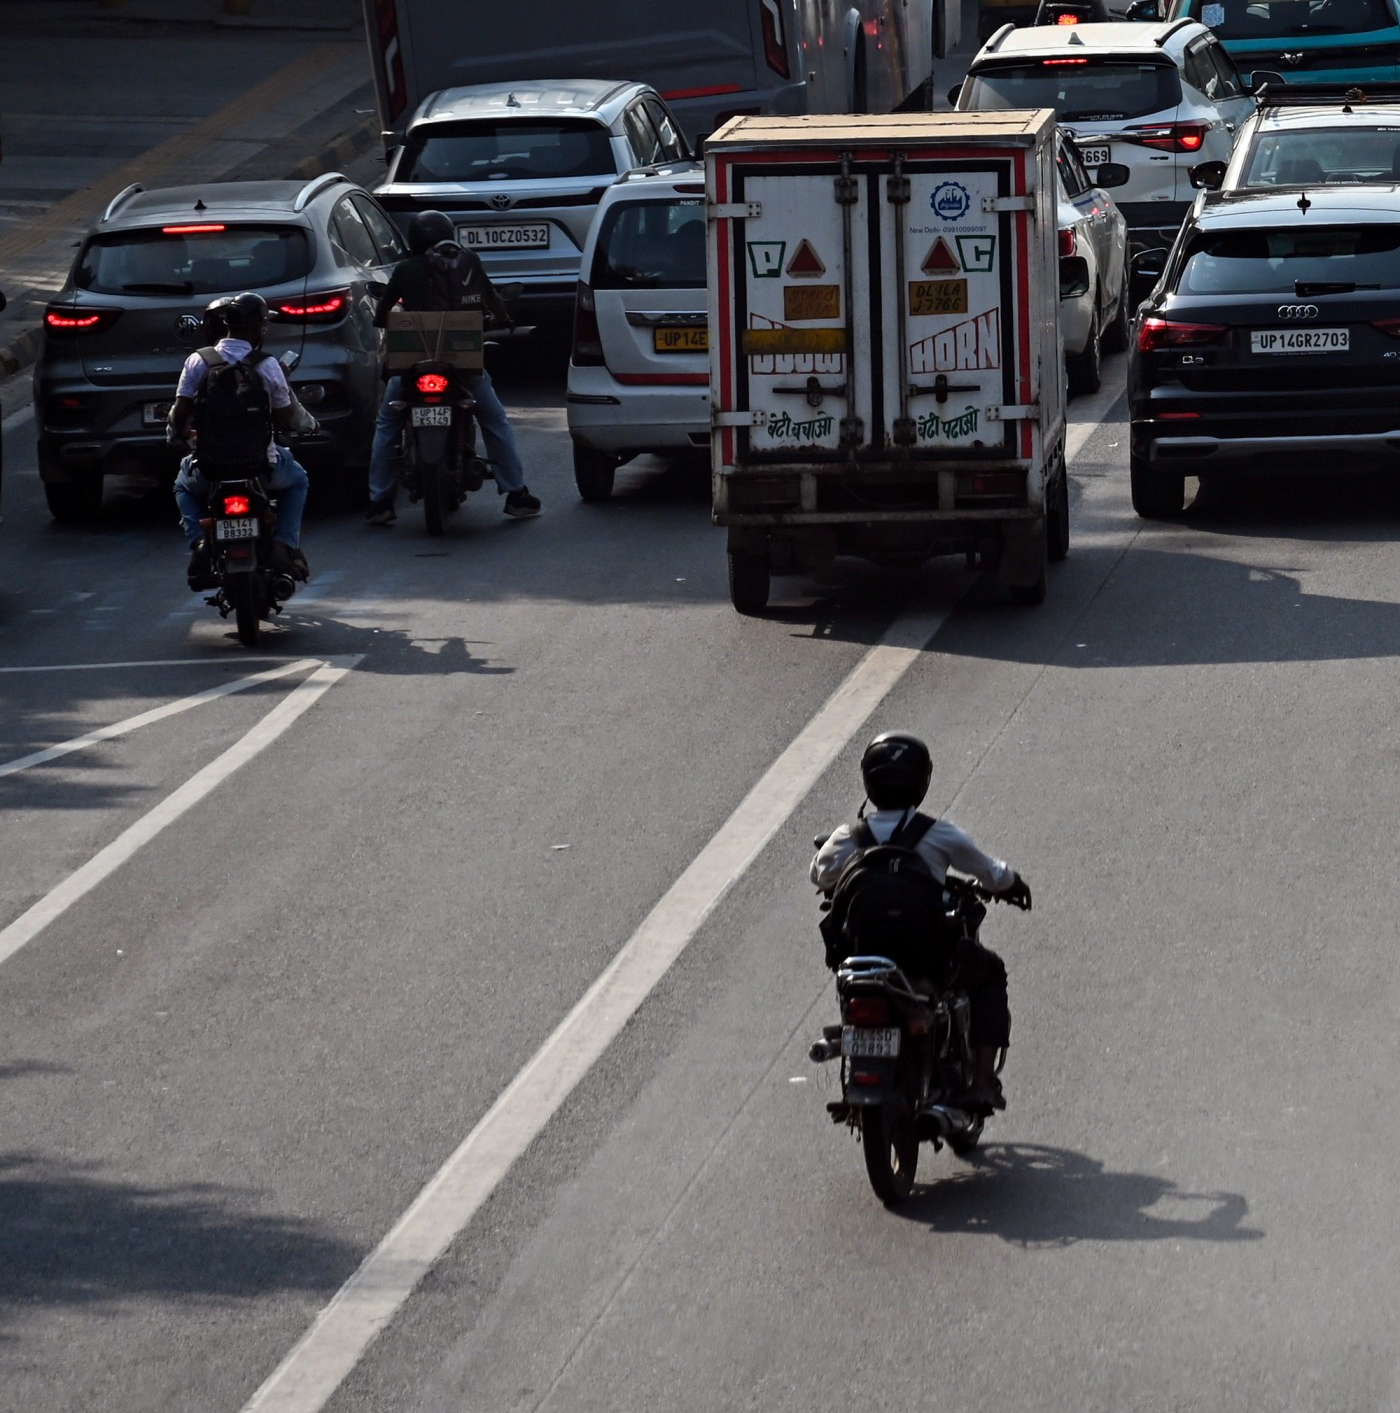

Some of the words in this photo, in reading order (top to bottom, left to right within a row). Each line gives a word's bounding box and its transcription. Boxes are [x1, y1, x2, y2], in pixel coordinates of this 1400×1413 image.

[468, 229, 547, 244] DL10CZ0532
[461, 294, 481, 304] NIKE
[664, 331, 707, 346] UP14E
[911, 307, 1000, 374] HORN
[1260, 332, 1347, 348] UP14GR2703
